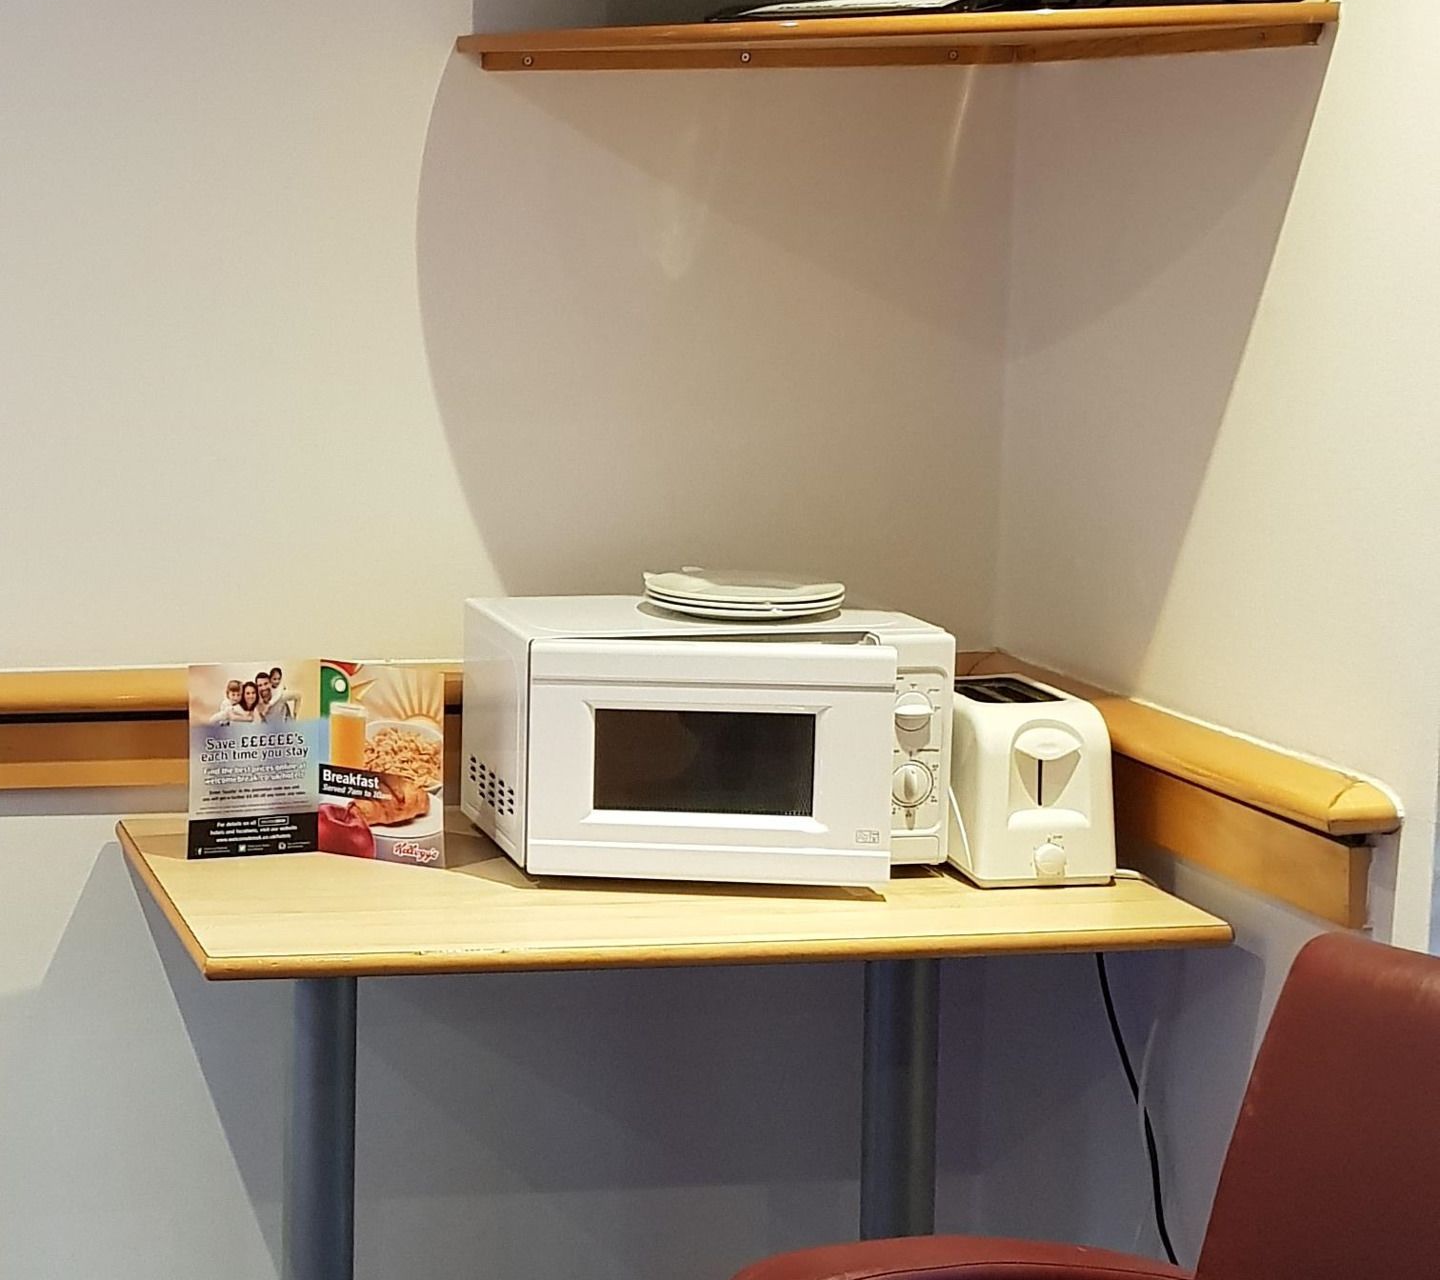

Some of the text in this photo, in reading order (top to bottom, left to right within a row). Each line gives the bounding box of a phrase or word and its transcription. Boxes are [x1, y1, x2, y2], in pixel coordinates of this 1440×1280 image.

[206, 738, 235, 750] Save
[201, 746, 309, 762] each time you stay
[322, 769, 379, 789] Breakfast
[322, 783, 346, 794] Served
[347, 787, 363, 796] 7am
[364, 789, 372, 797] to
[393, 841, 440, 863] Kellogg's
